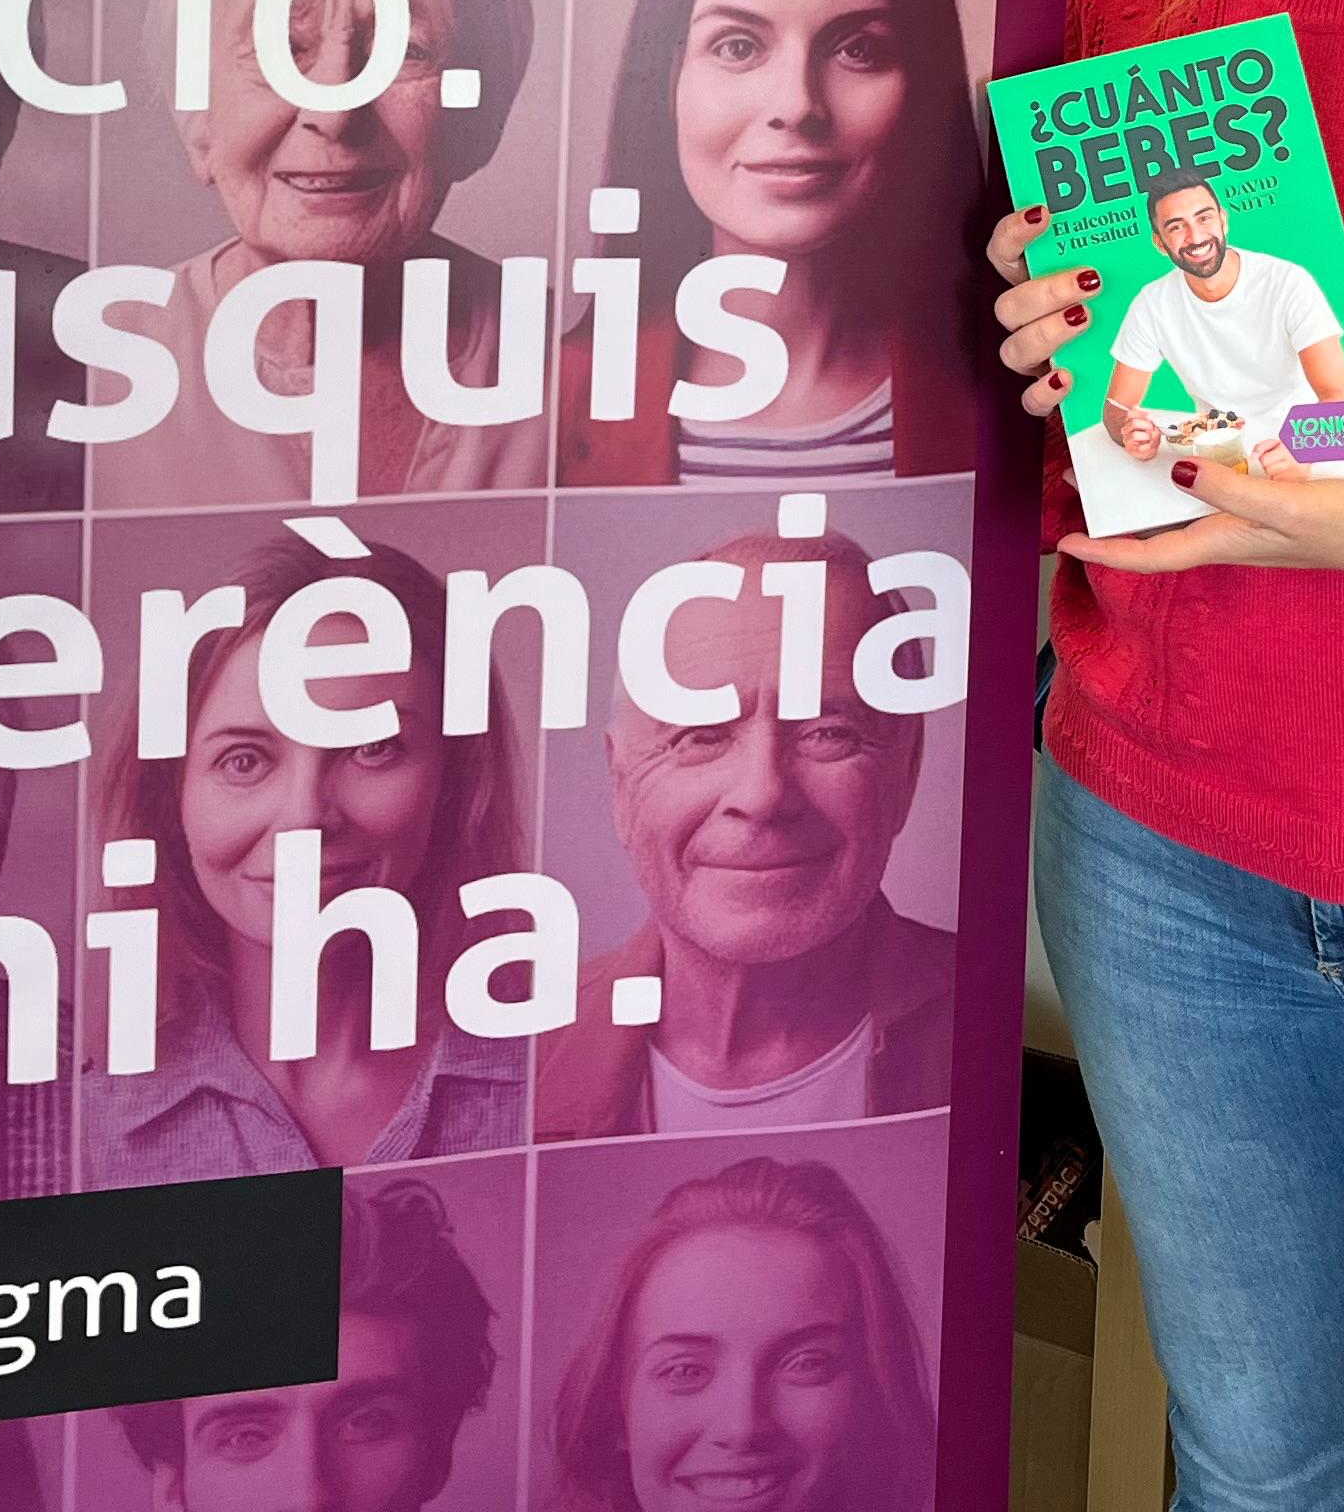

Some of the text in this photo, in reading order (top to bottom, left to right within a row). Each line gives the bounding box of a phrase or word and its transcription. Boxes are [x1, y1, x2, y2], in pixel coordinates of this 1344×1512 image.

[1030, 48, 1275, 144] ¿CUÁNTO
[1035, 95, 1292, 213] BEBES?
[1224, 175, 1278, 199] DAVID
[1052, 206, 1138, 237] El alcohol
[1057, 221, 1140, 256] y tu salud
[270, 829, 662, 1062] ha.
